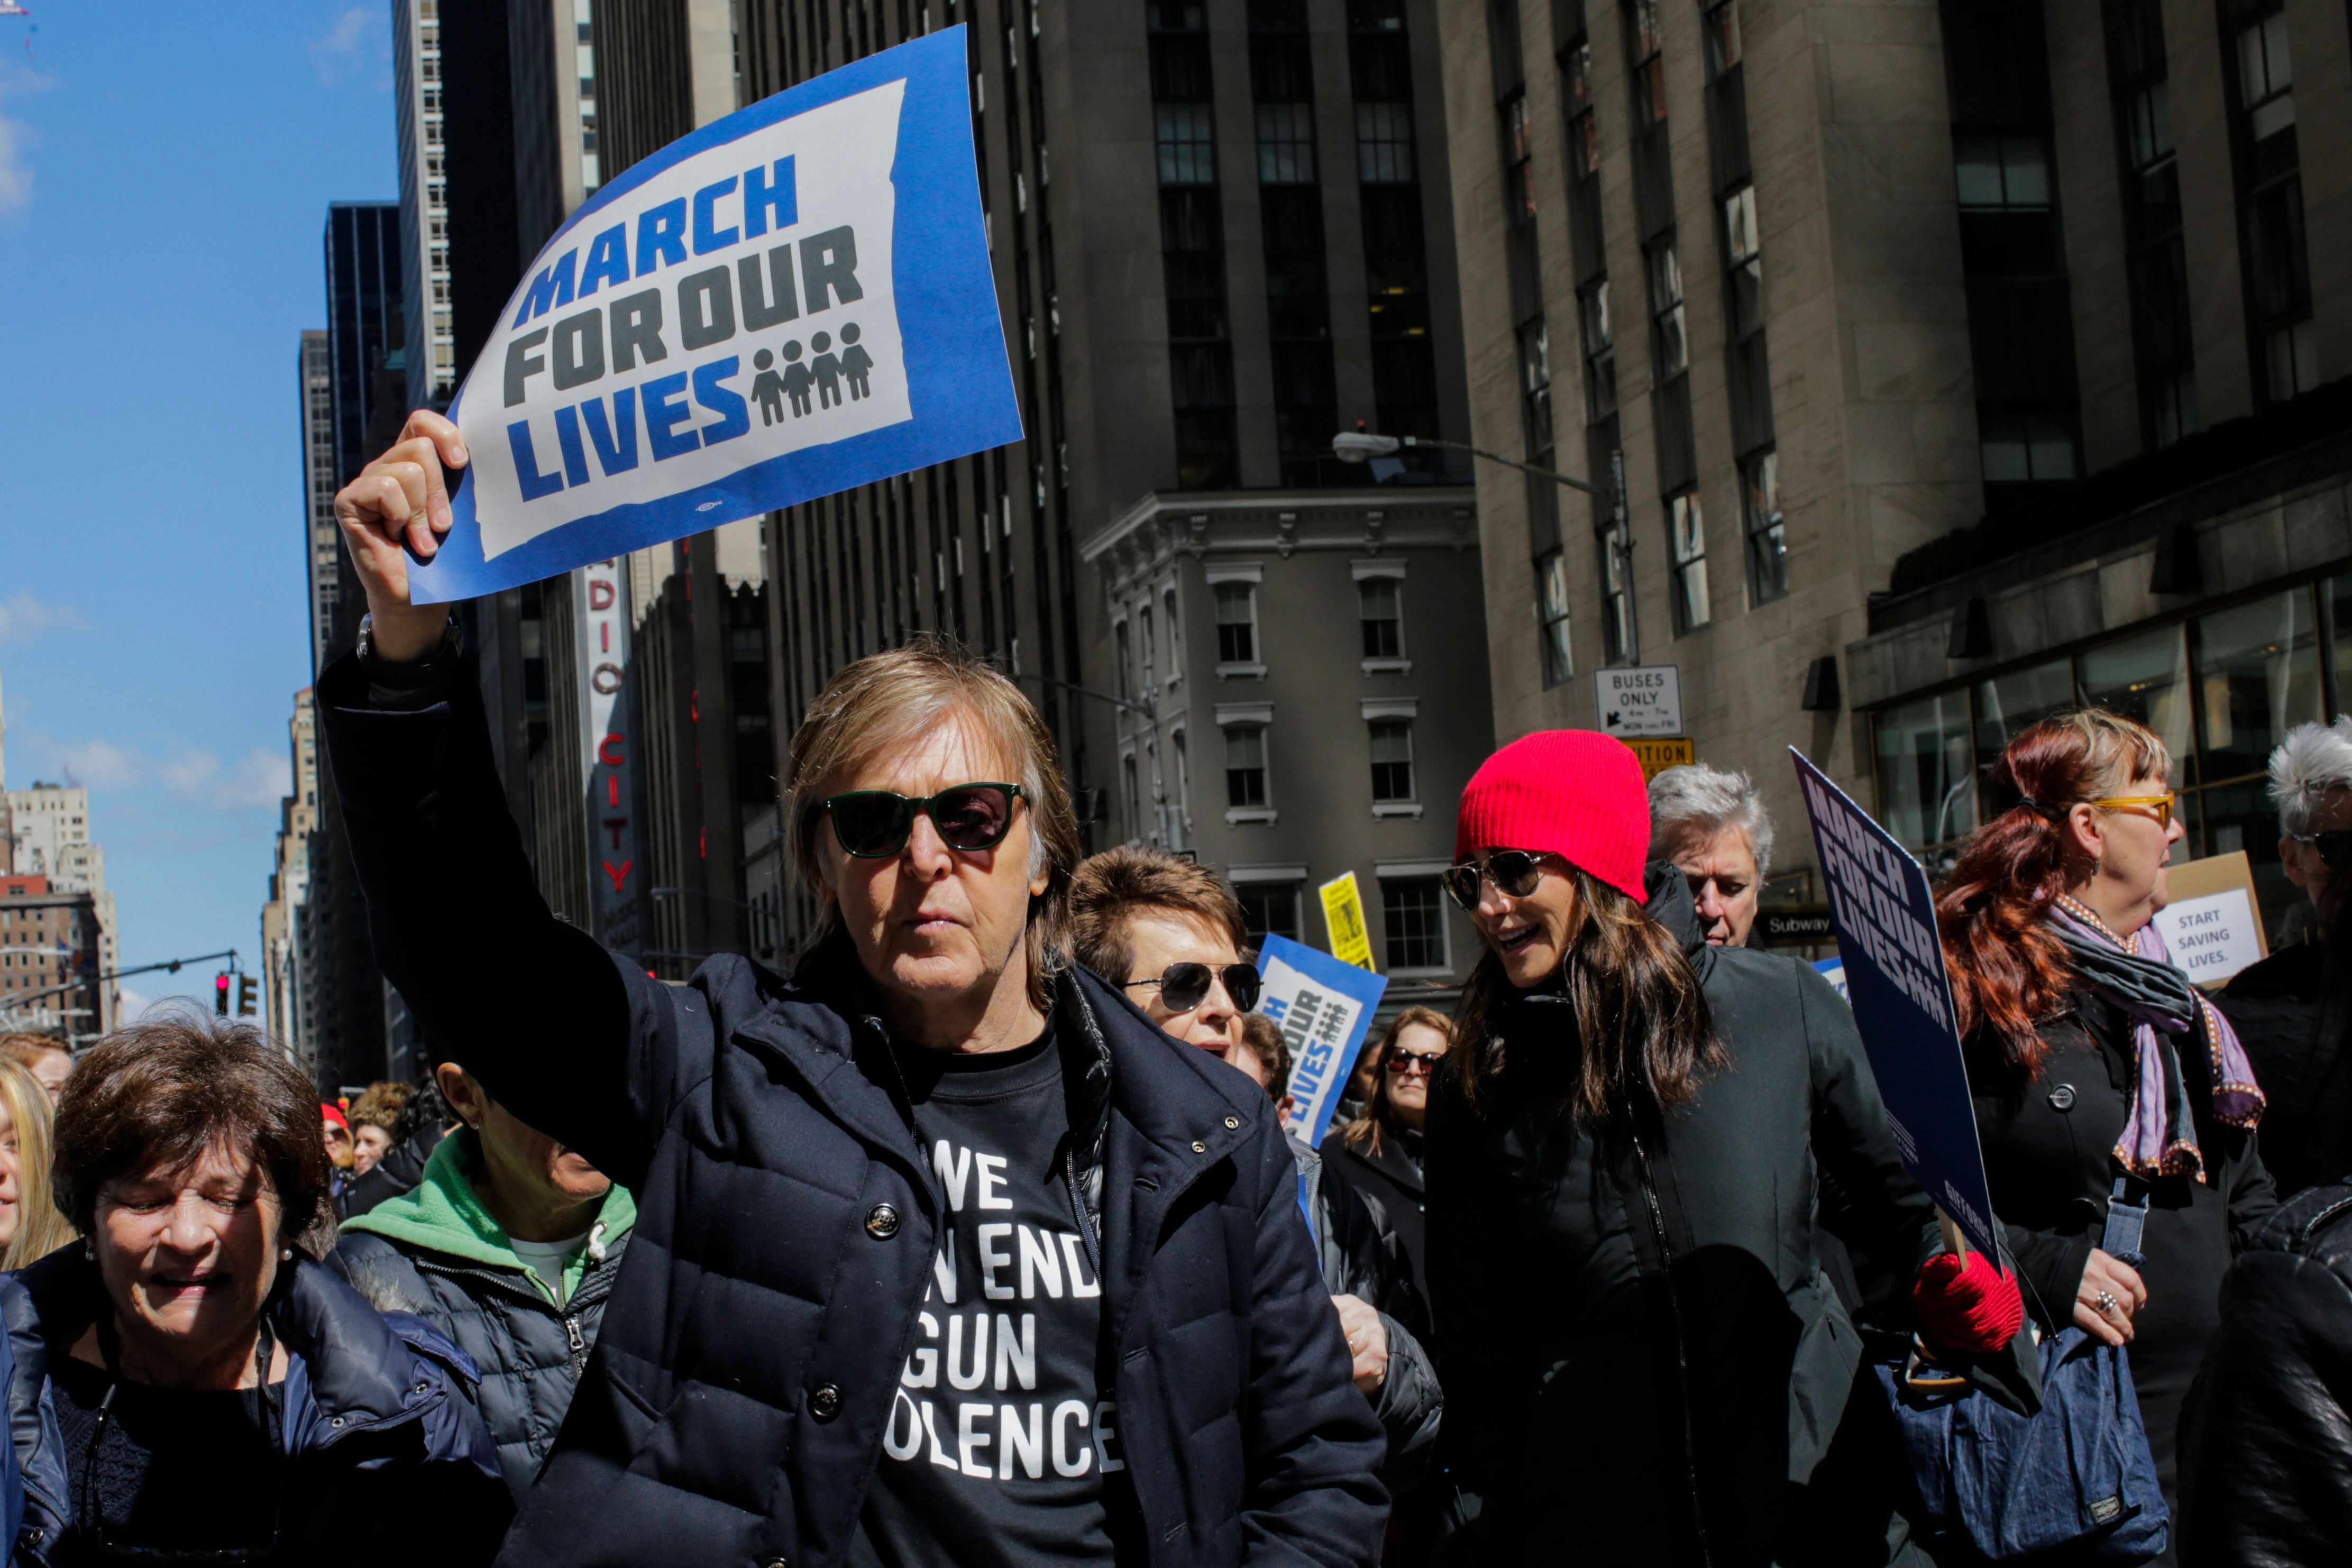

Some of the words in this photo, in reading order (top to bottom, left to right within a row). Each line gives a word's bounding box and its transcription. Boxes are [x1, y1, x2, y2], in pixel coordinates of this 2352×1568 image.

[510, 153, 799, 331] MARCH
[504, 287, 667, 408] FOR
[677, 225, 864, 351] OUR
[507, 355, 751, 502] LIVES
[588, 558, 623, 695] DIO
[1613, 673, 1664, 689] BUSES
[1620, 691, 1659, 706] ONLY
[1634, 746, 1686, 762] TION
[599, 733, 633, 892] CITY
[1805, 773, 1910, 906] MARCH
[1769, 917, 1831, 933] Subway
[1818, 825, 1875, 921] FOR
[1871, 882, 1939, 979] OUR
[1831, 880, 1908, 996] LIVES
[2178, 929, 2230, 949] SAVING
[2179, 910, 2220, 928] START
[2188, 951, 2229, 968] LIVES.
[1283, 989, 1323, 1052] OUR
[1289, 1039, 1333, 1122] LIVES
[901, 1311, 1036, 1391] GUN
[883, 1386, 1125, 1480] OLENCE
